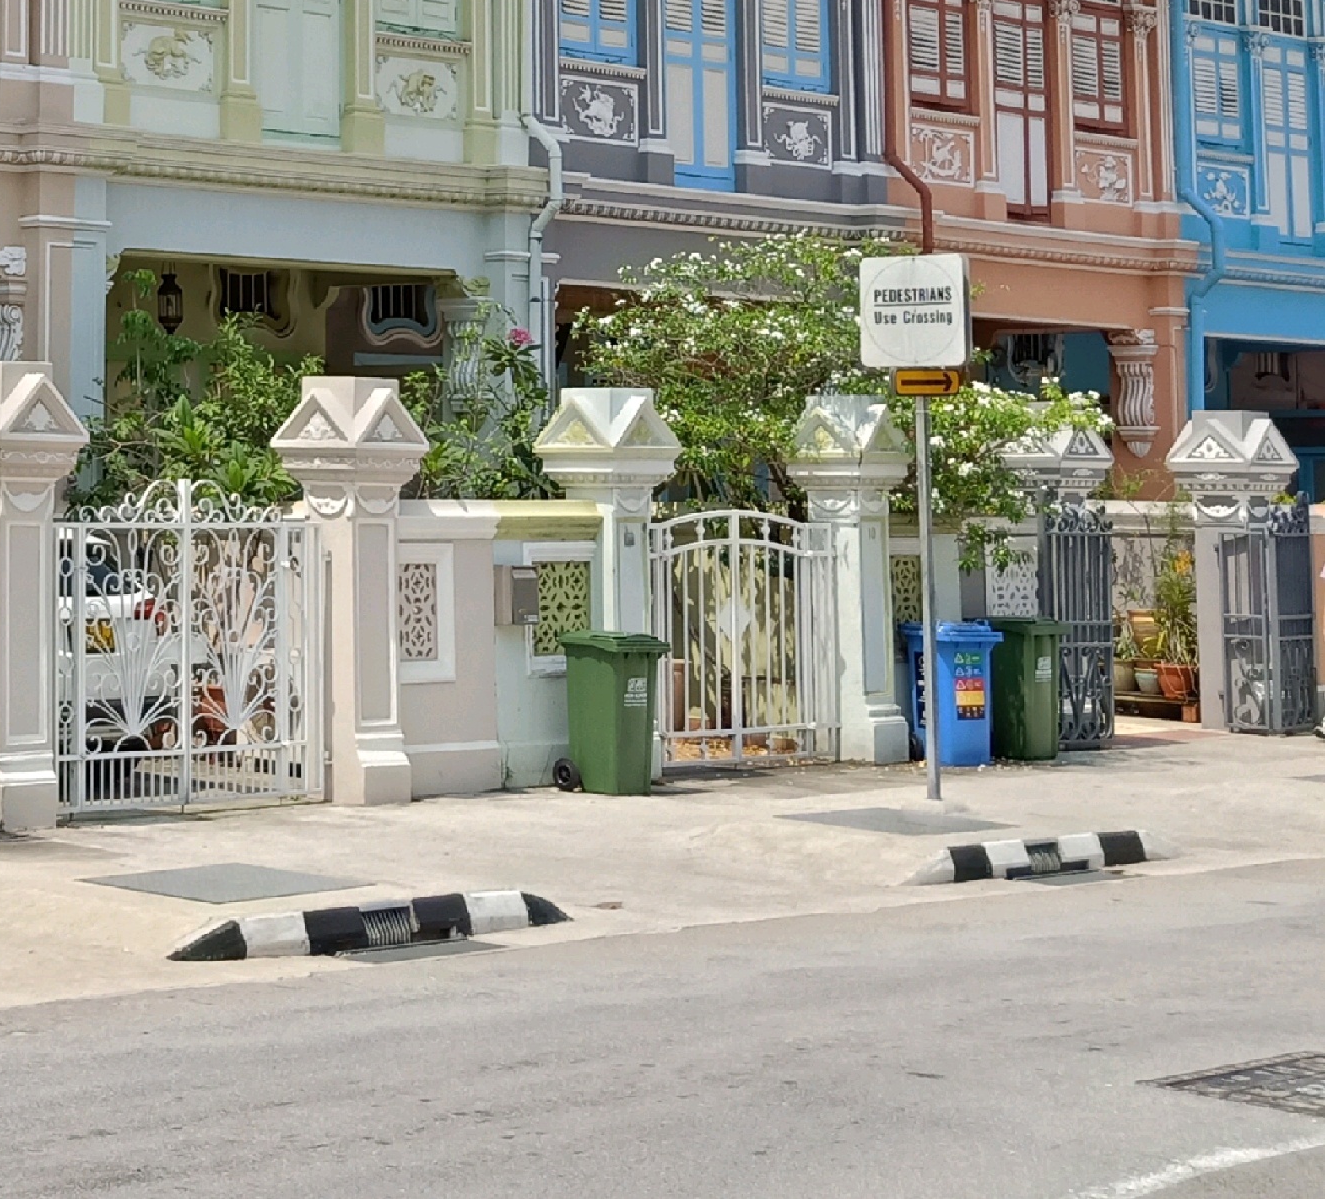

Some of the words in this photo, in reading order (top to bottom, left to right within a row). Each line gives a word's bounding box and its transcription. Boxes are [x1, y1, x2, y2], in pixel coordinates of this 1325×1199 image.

[874, 286, 952, 302] PEDESTRIANS
[874, 311, 897, 325] Use
[903, 309, 953, 326] Crossing
